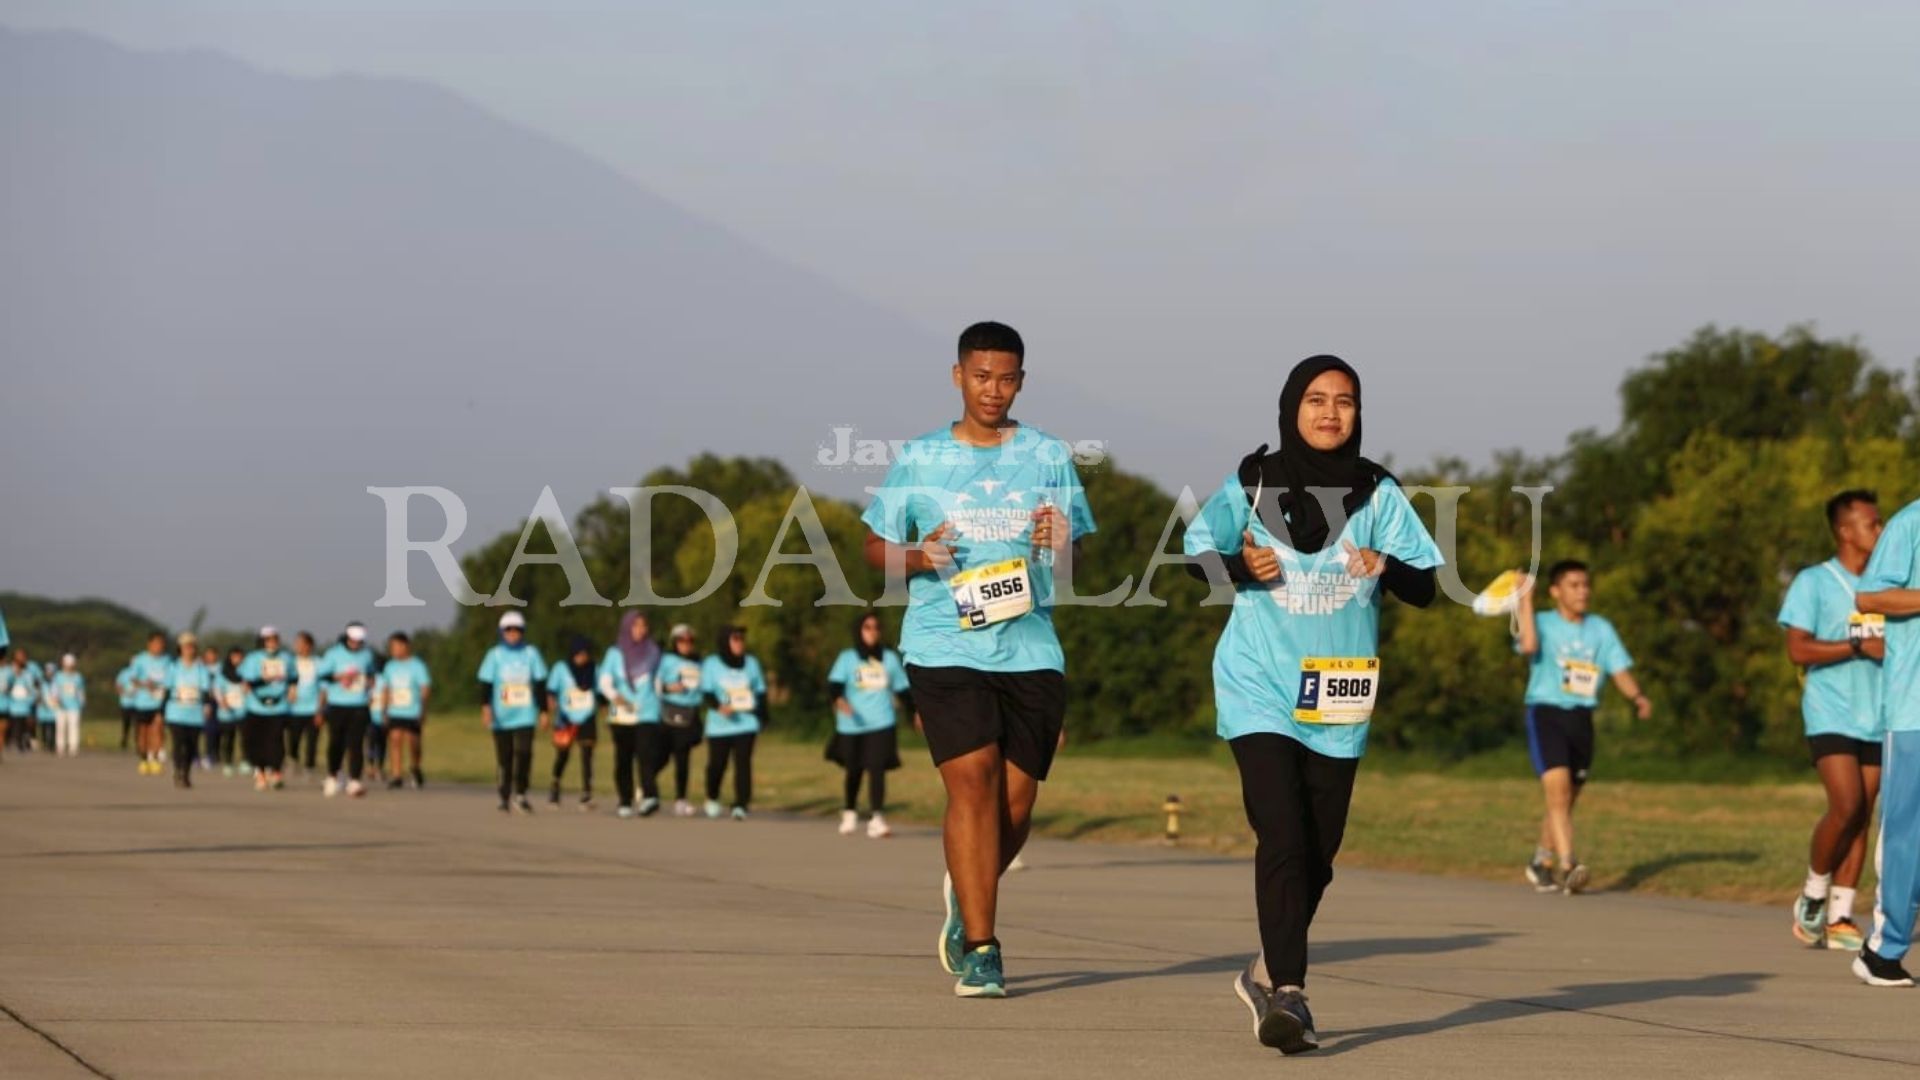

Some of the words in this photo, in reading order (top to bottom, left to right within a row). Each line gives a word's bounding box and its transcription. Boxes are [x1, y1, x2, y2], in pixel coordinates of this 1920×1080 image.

[980, 577, 1023, 600] 5856
[1288, 594, 1333, 615] RUN
[1304, 678, 1316, 696] F
[1326, 678, 1371, 697] 5808
